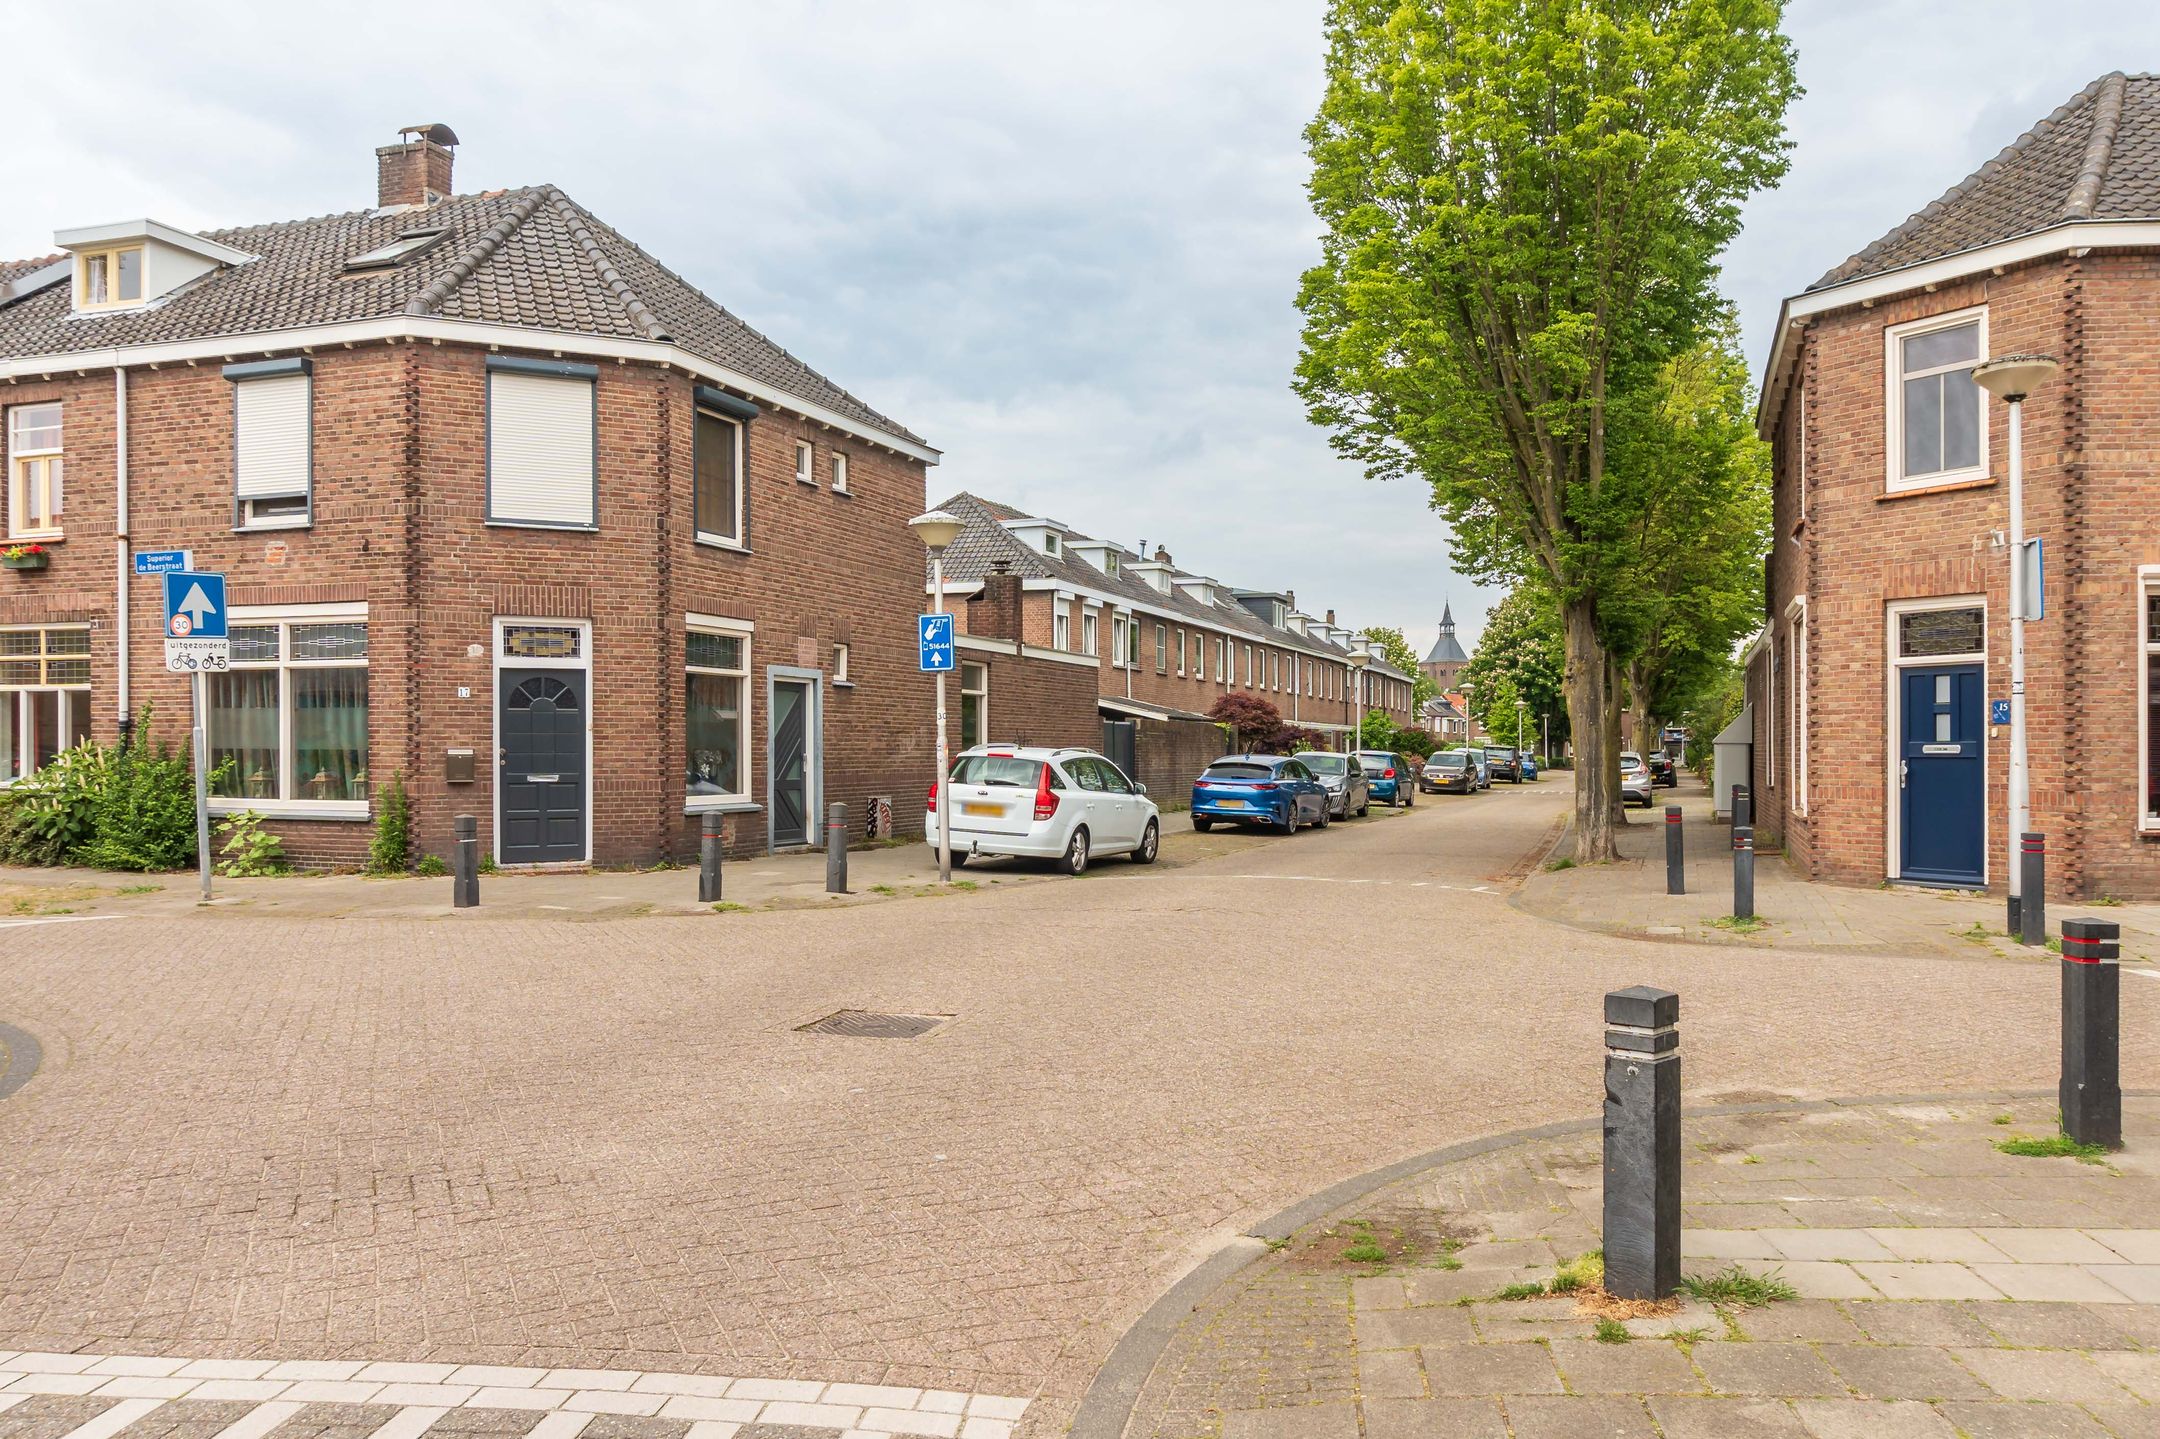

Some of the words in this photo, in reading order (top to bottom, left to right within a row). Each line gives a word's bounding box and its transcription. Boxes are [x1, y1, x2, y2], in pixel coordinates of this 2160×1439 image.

[146, 554, 173, 562] Superior
[147, 562, 183, 571] Beerstraat
[175, 620, 188, 630] 30
[170, 642, 227, 650] uitgezonderd
[929, 642, 950, 650] 51644
[459, 688, 469, 697] 17
[1999, 702, 2008, 711] 15
